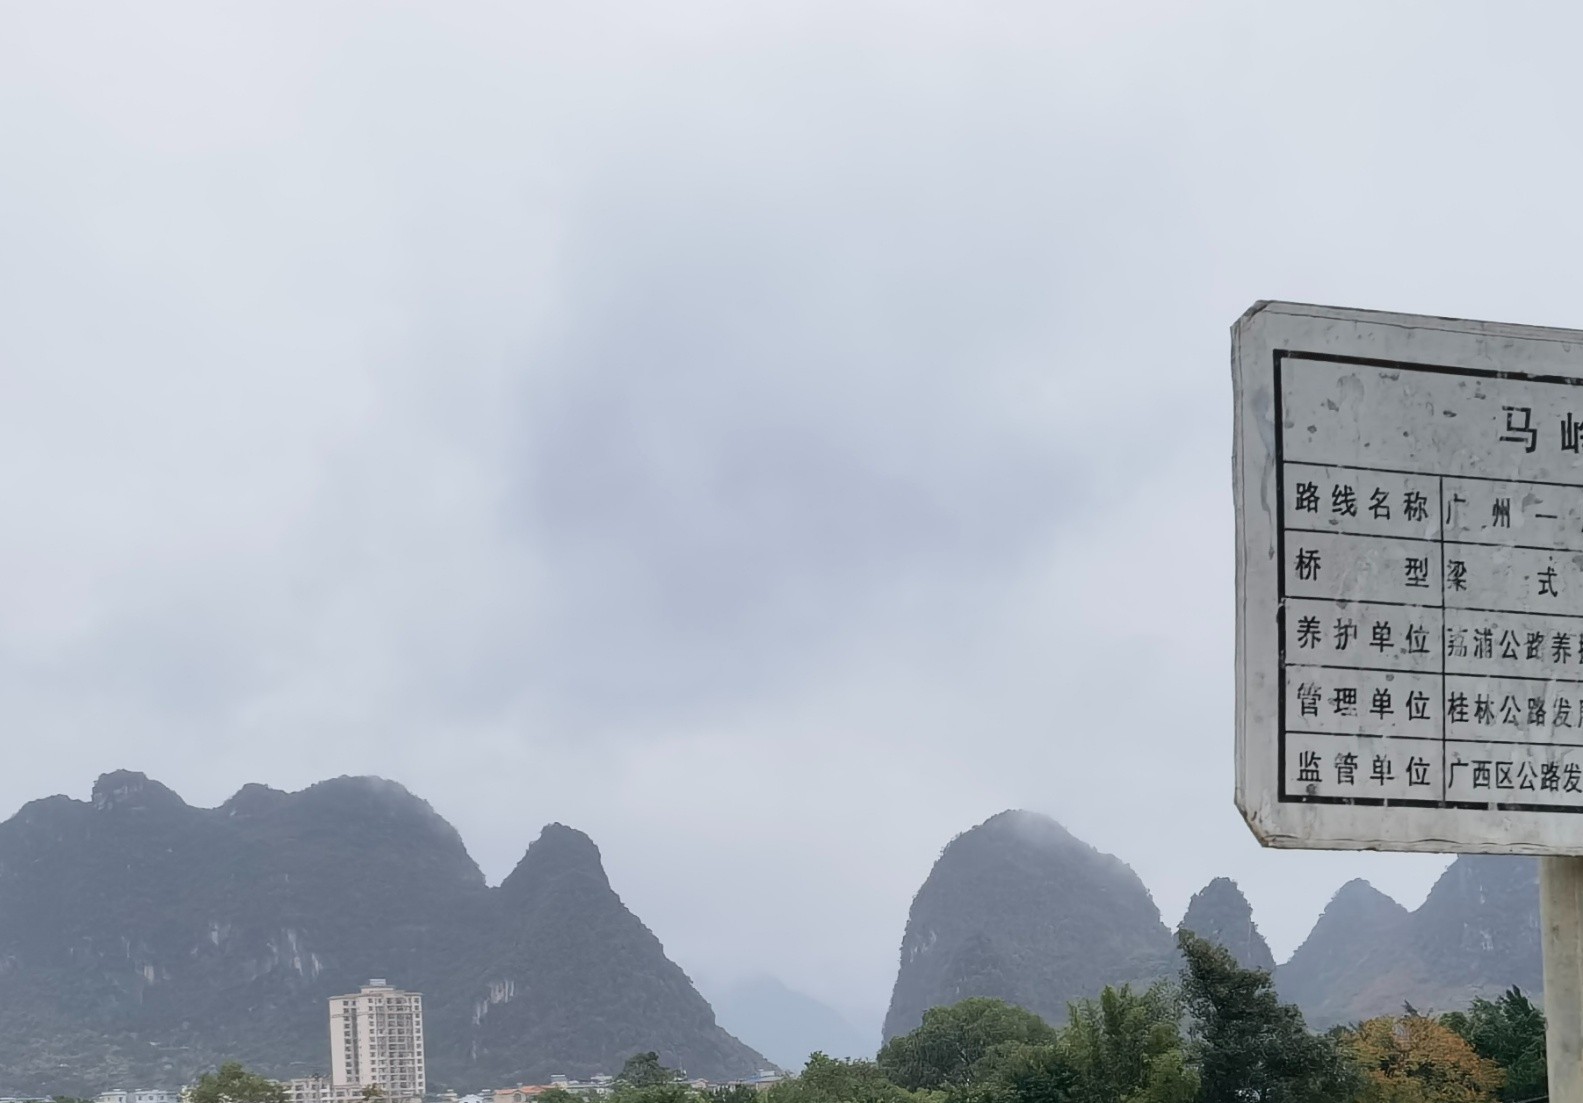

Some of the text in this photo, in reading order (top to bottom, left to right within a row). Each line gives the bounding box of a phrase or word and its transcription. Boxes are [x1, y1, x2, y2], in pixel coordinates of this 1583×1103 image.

[1295, 481, 1429, 521] 路线名称
[1296, 616, 1430, 654] 养护单位
[1296, 682, 1431, 721] 管理单位
[1296, 751, 1431, 787] 监管单位
